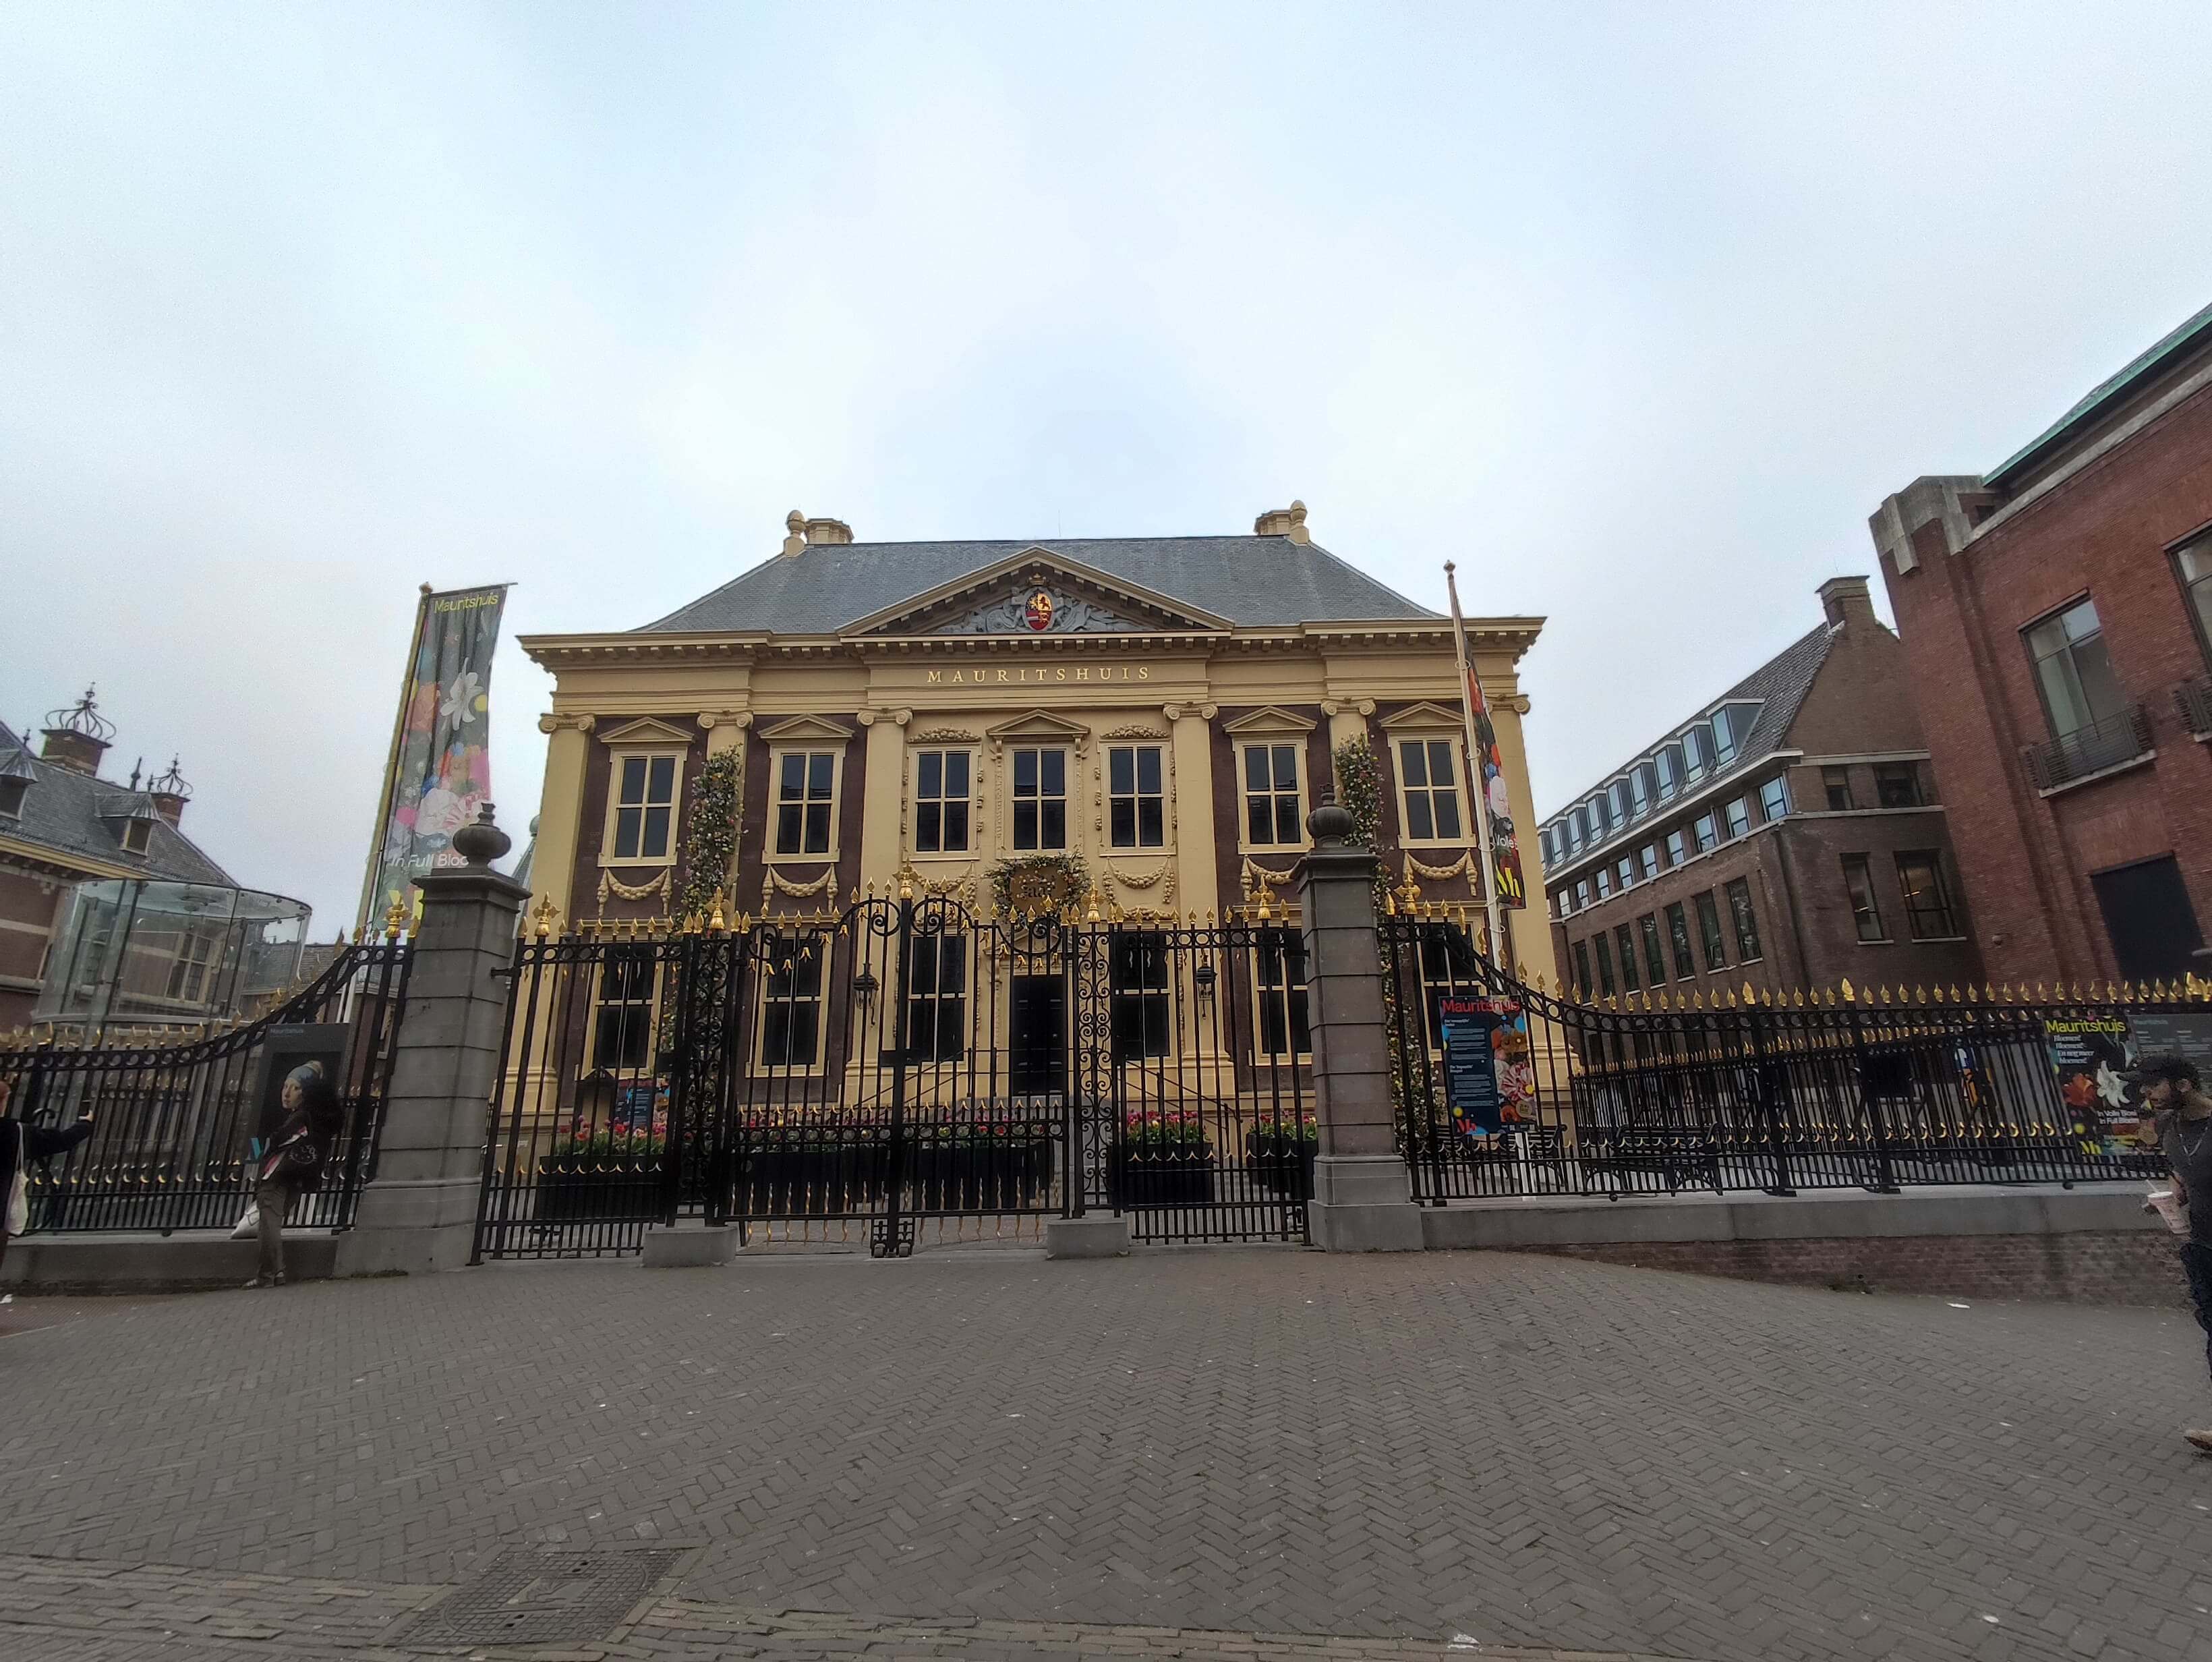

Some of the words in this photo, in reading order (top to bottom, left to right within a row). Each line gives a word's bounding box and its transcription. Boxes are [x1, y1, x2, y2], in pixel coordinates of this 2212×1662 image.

[434, 592, 499, 613] Mauritshuis
[927, 666, 1148, 683] MAURITSHUIS
[407, 855, 434, 867] Full
[1443, 999, 1520, 1013] Mauritshuis
[2045, 1019, 2126, 1033] Mauritshuis
